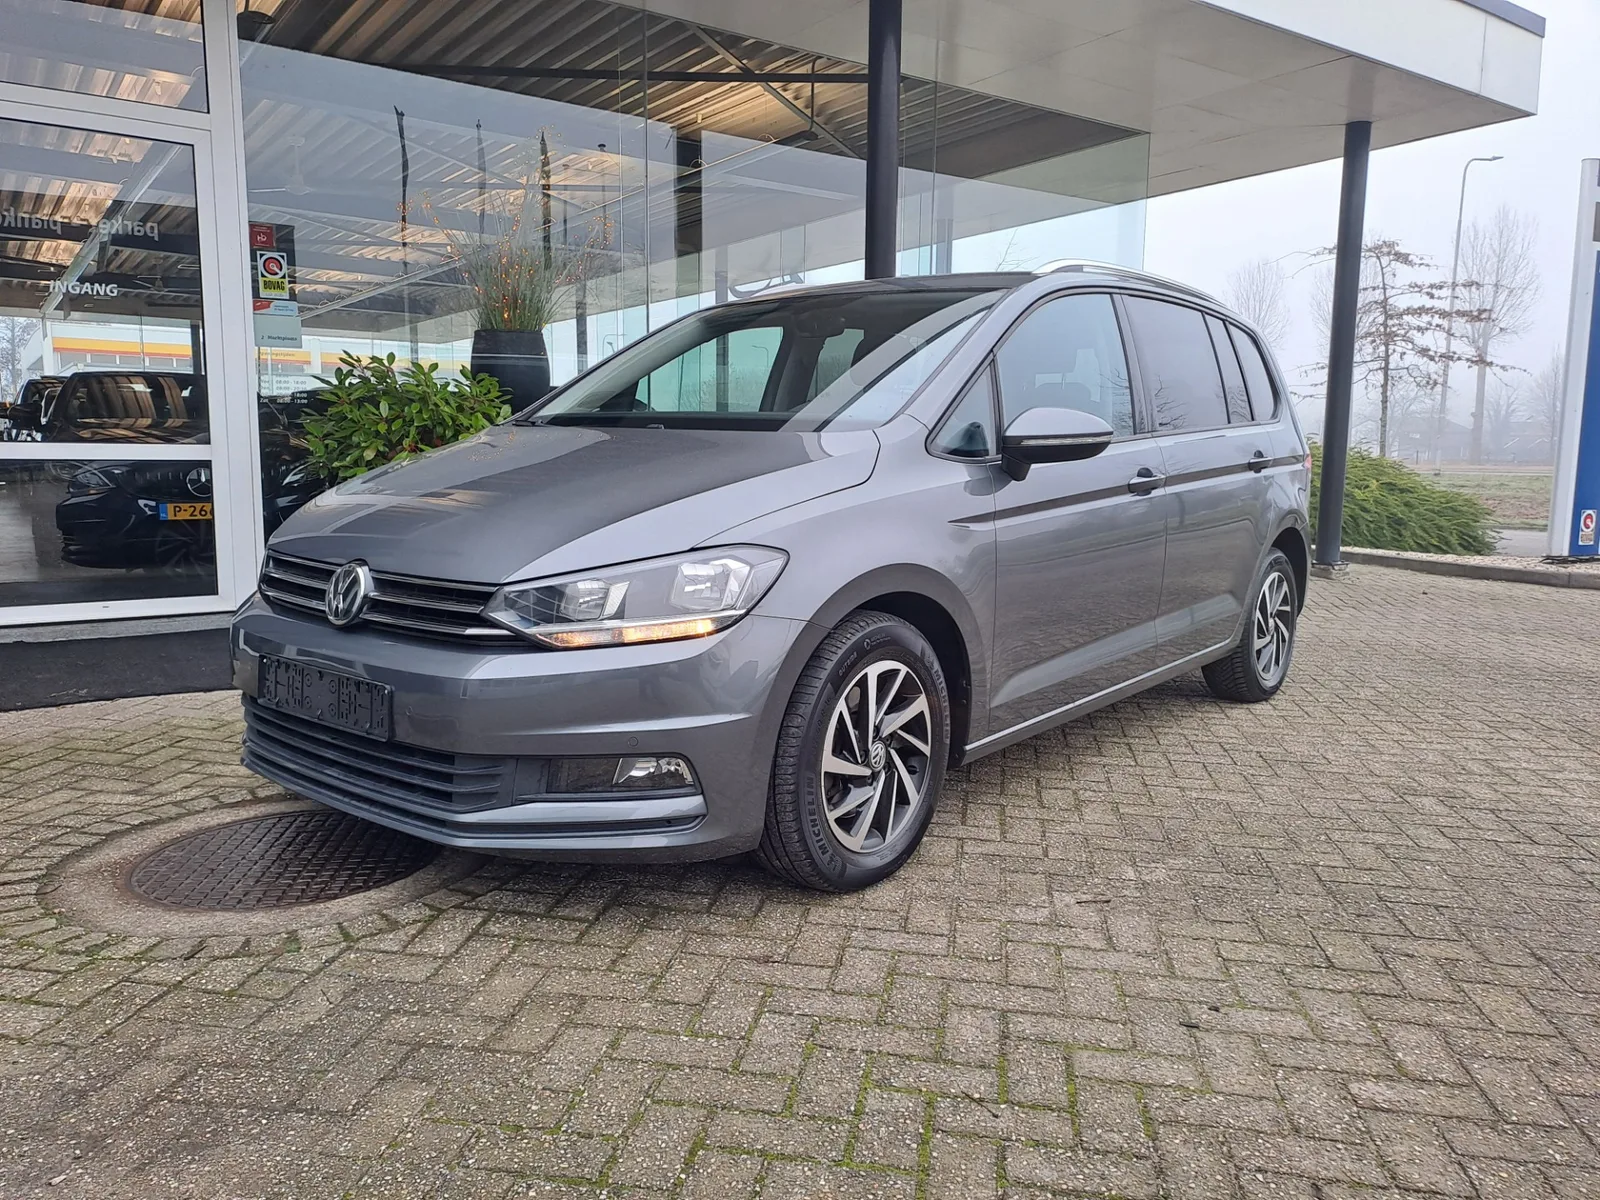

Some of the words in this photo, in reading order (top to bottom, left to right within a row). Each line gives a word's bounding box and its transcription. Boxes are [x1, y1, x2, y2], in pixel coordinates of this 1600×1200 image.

[49, 279, 118, 297] INGANG
[263, 279, 285, 291] BOVAG
[805, 776, 830, 857] MICHELIN
